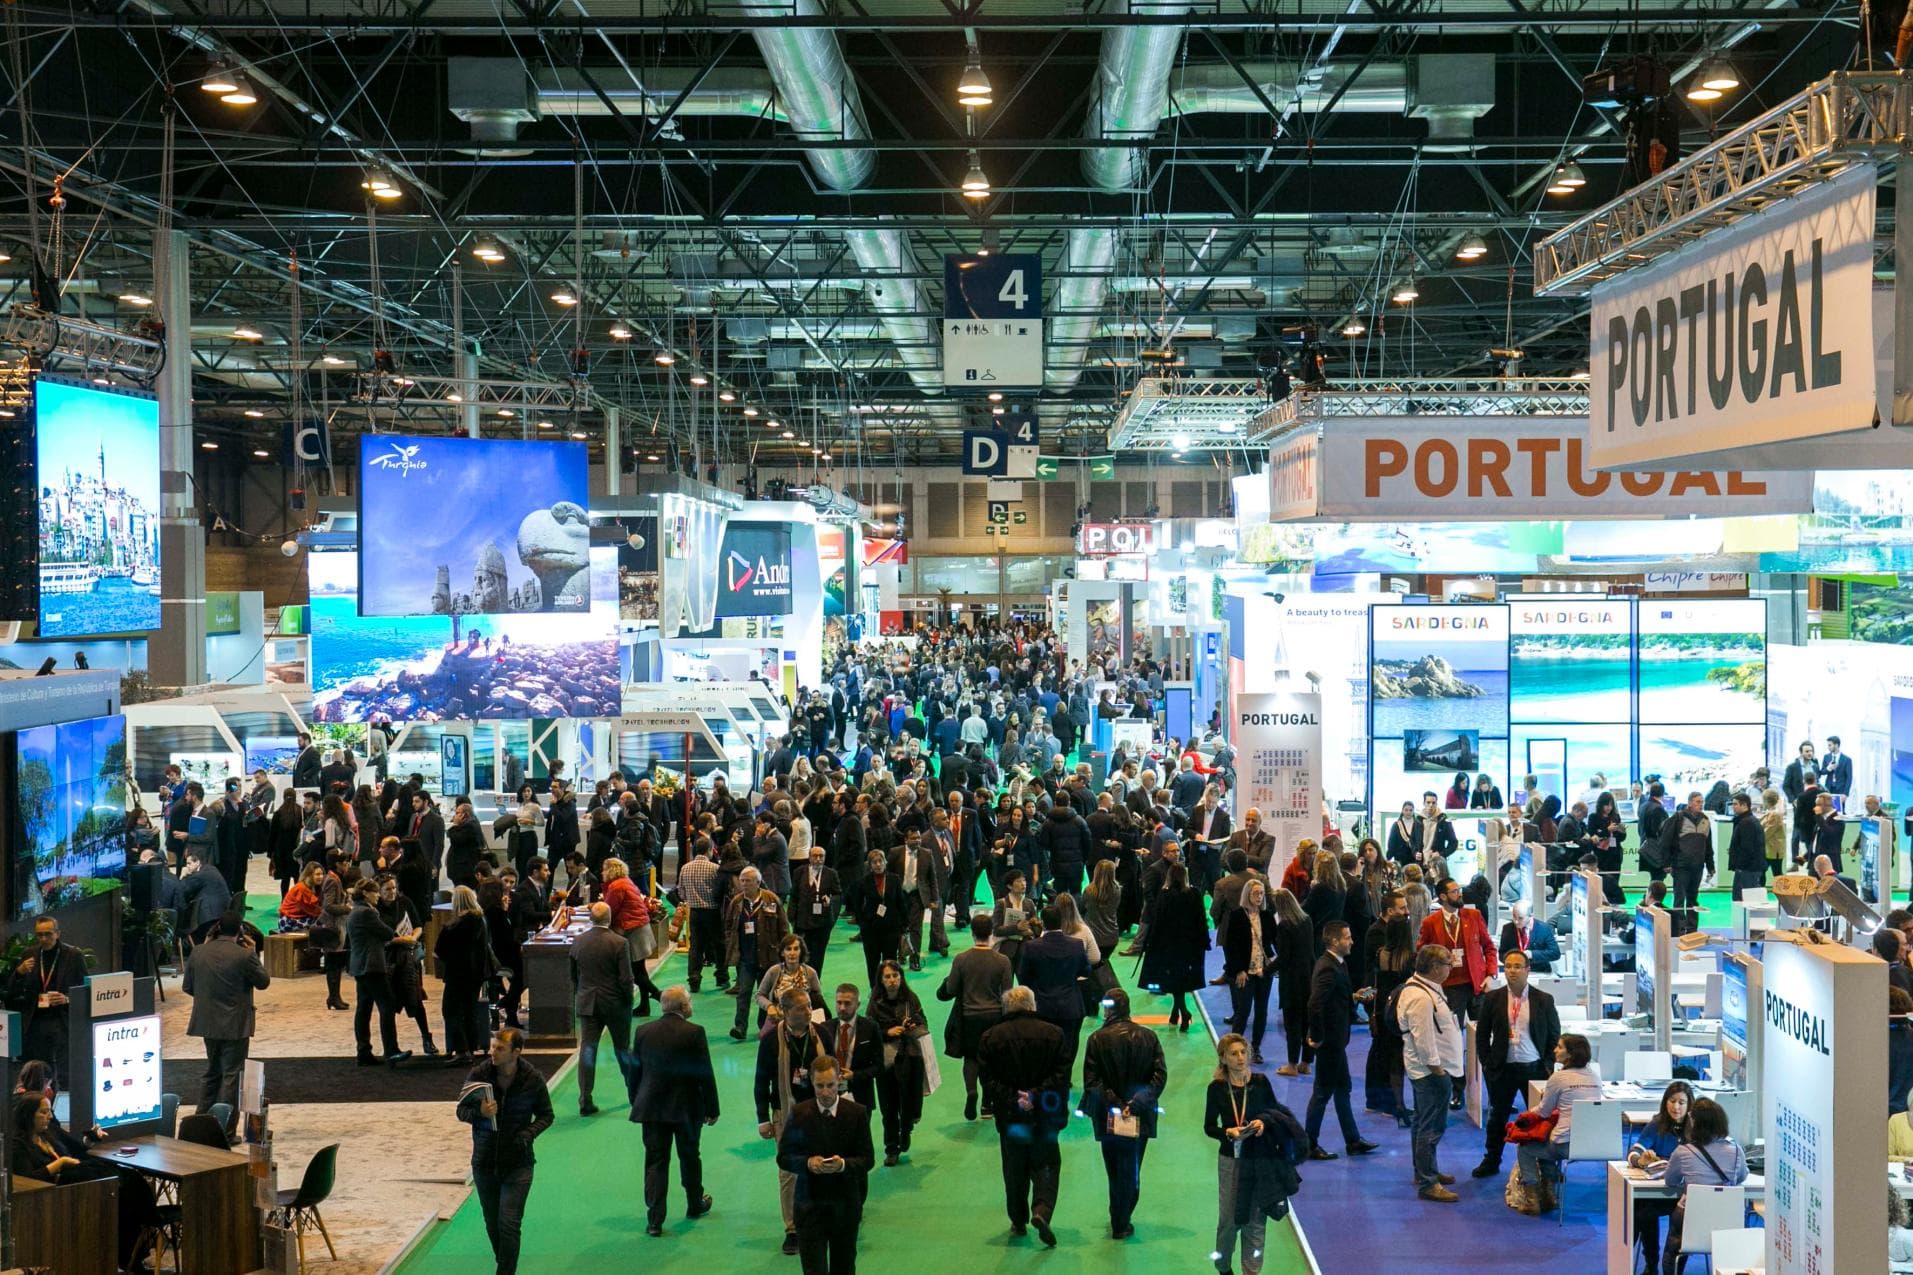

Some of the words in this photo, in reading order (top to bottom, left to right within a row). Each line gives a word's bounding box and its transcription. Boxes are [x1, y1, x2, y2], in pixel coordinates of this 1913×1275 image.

[998, 269, 1029, 310] 4
[1608, 238, 1841, 432] PORTUGAL
[1017, 421, 1033, 442] 4
[295, 428, 320, 460] C
[971, 437, 999, 469] D
[1295, 608, 1328, 618] beauty
[1331, 608, 1342, 616] to
[1523, 611, 1613, 624] SARDEGNA
[1392, 616, 1490, 630] SARDEGNA
[1241, 713, 1319, 726] PORTUGAL
[96, 988, 120, 1002] intra
[1766, 989, 1830, 1056] PORTUGAL
[107, 1027, 139, 1041] intra
